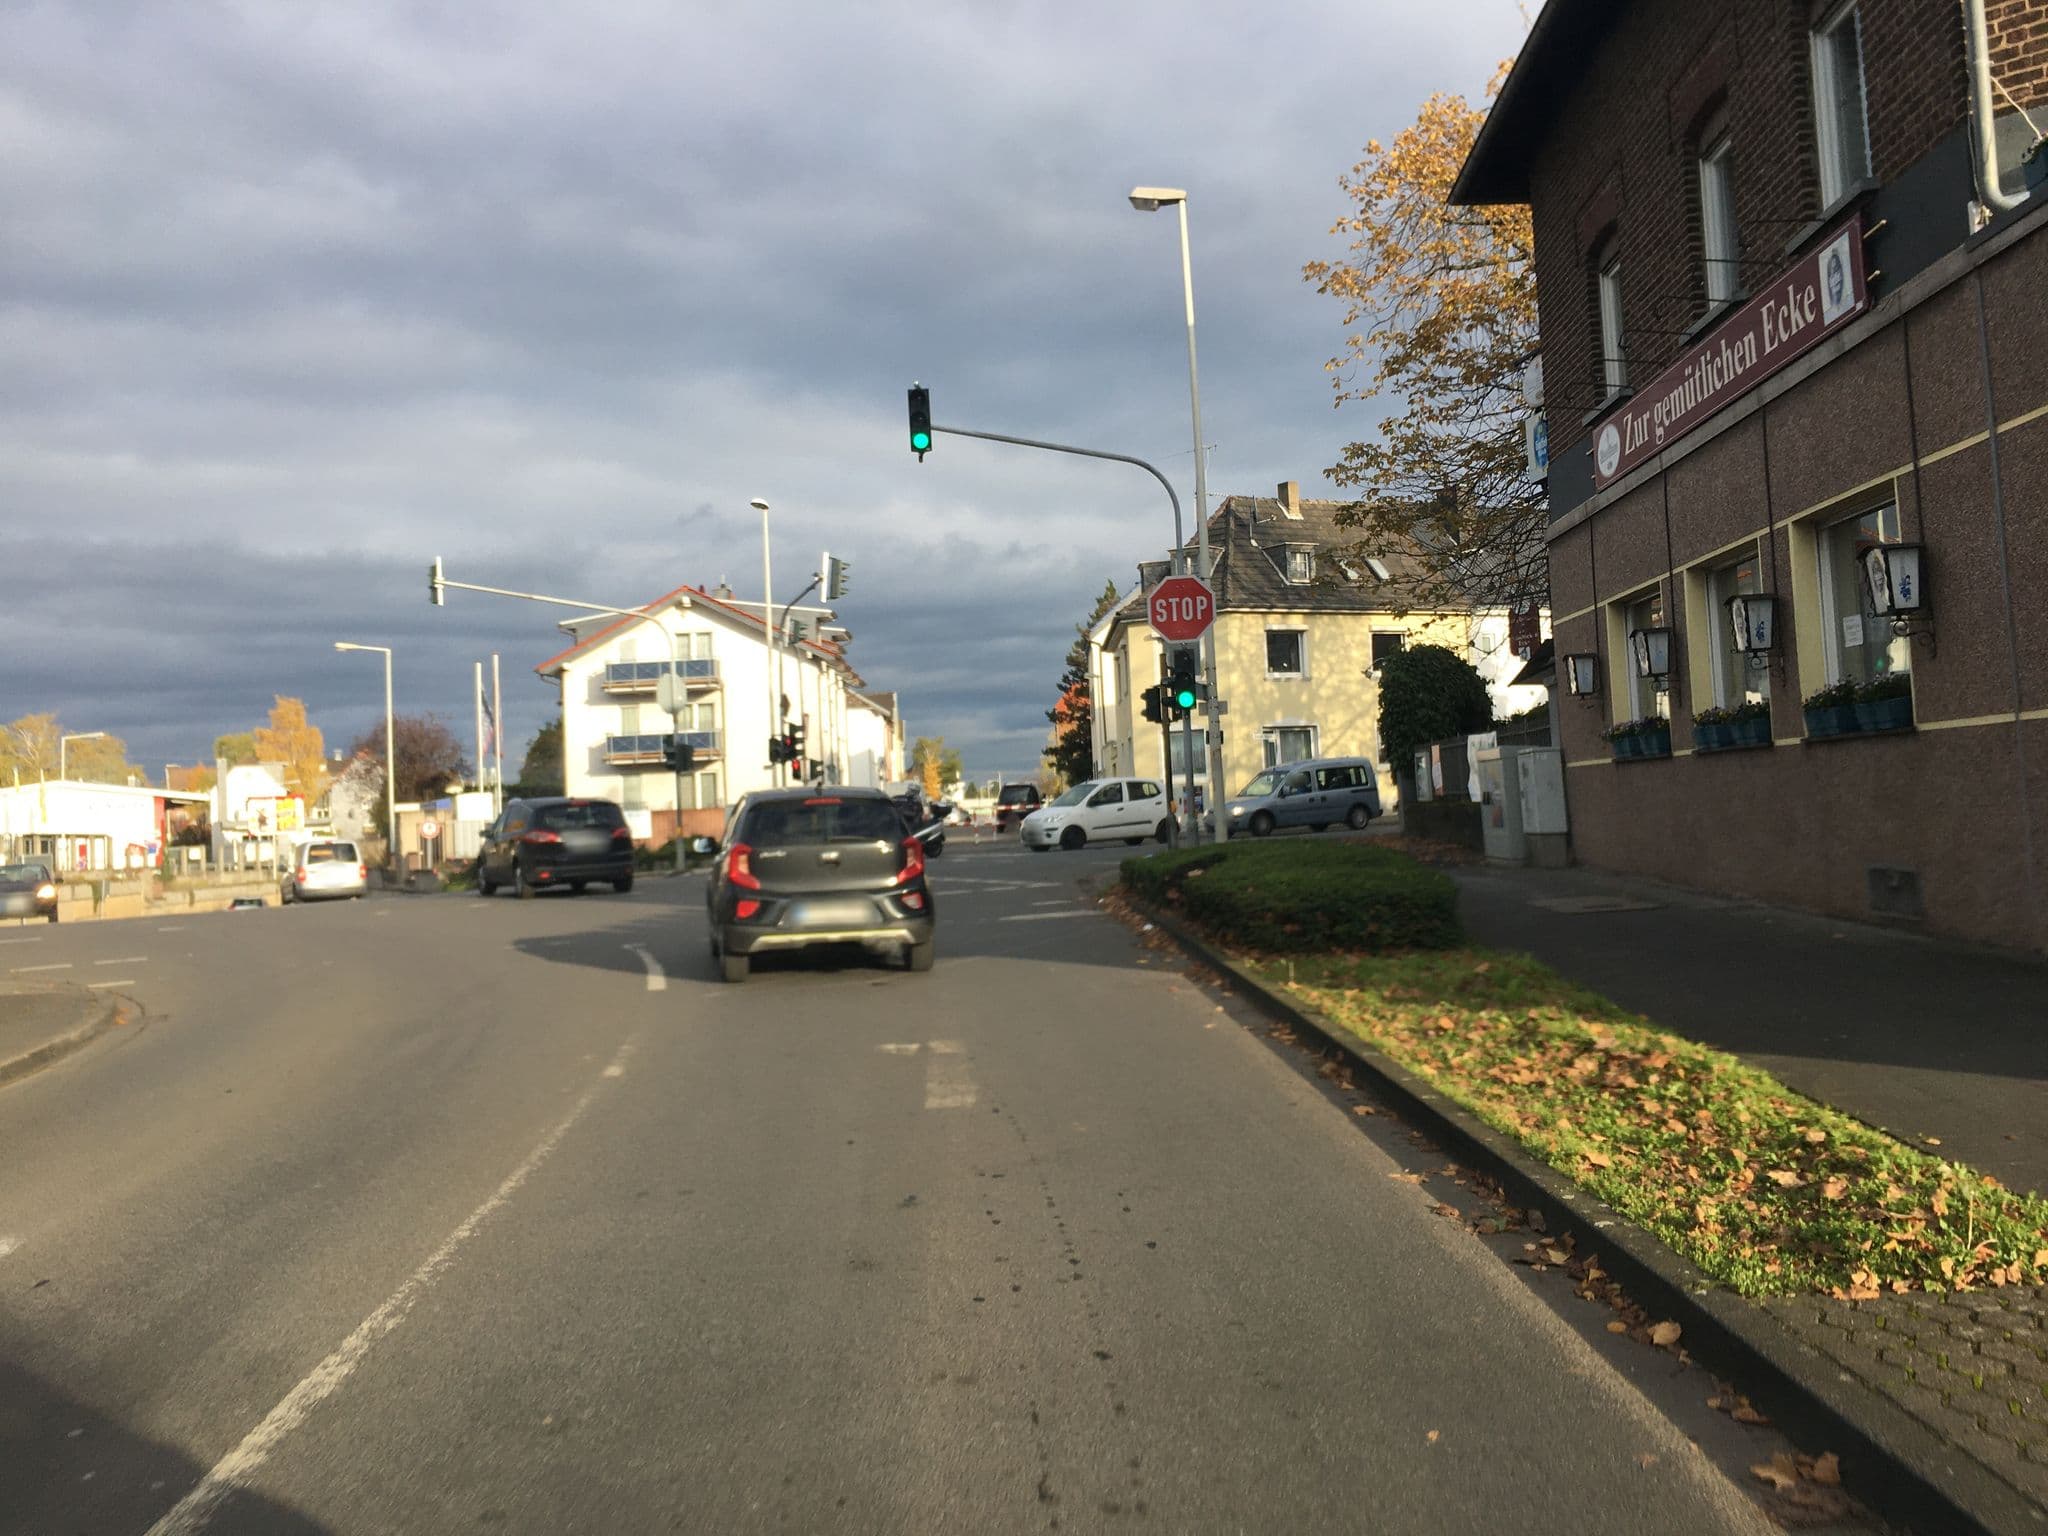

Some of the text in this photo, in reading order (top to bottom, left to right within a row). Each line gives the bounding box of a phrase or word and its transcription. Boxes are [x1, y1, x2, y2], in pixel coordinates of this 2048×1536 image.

[1623, 283, 1817, 456] Zur gemütlichen Ecke
[1155, 595, 1208, 623] STOP
